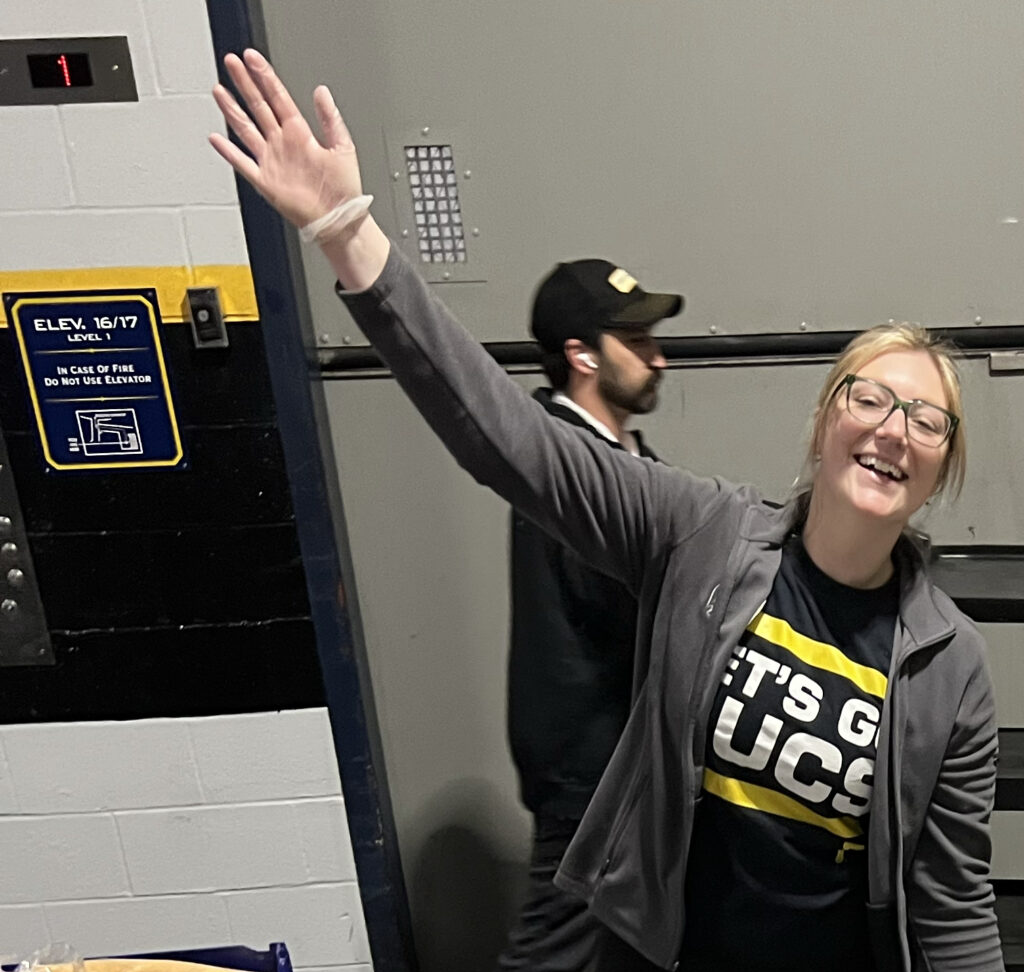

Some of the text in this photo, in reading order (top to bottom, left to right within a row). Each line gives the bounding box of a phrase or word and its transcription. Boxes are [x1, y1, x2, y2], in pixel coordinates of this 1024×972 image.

[57, 54, 71, 87] 1
[34, 316, 138, 331] ELEV. 16/17
[67, 333, 102, 342] LEVEL
[837, 698, 880, 750] G
